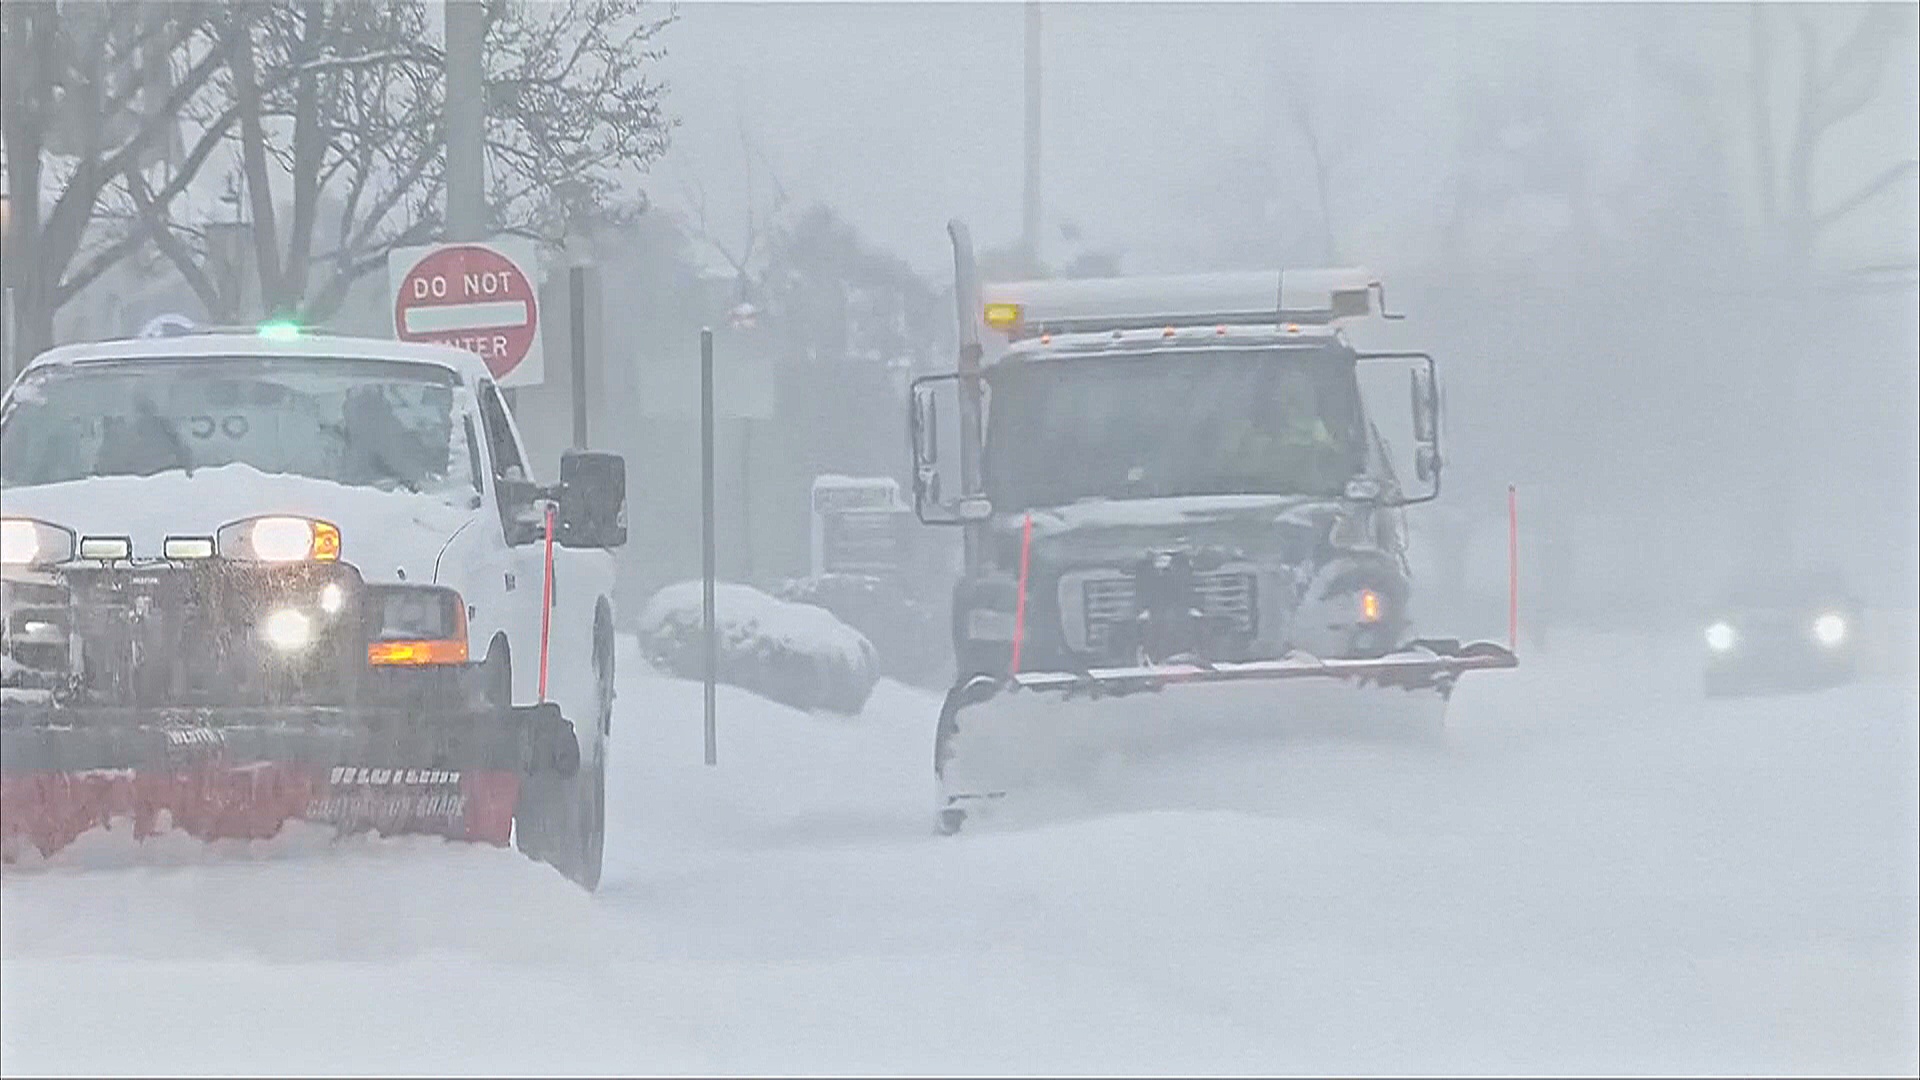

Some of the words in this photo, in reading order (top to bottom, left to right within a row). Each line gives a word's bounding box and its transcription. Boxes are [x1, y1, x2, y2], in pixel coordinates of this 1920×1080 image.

[413, 275, 447, 299] DO
[463, 272, 512, 297] NOT
[435, 335, 508, 359] NTER
